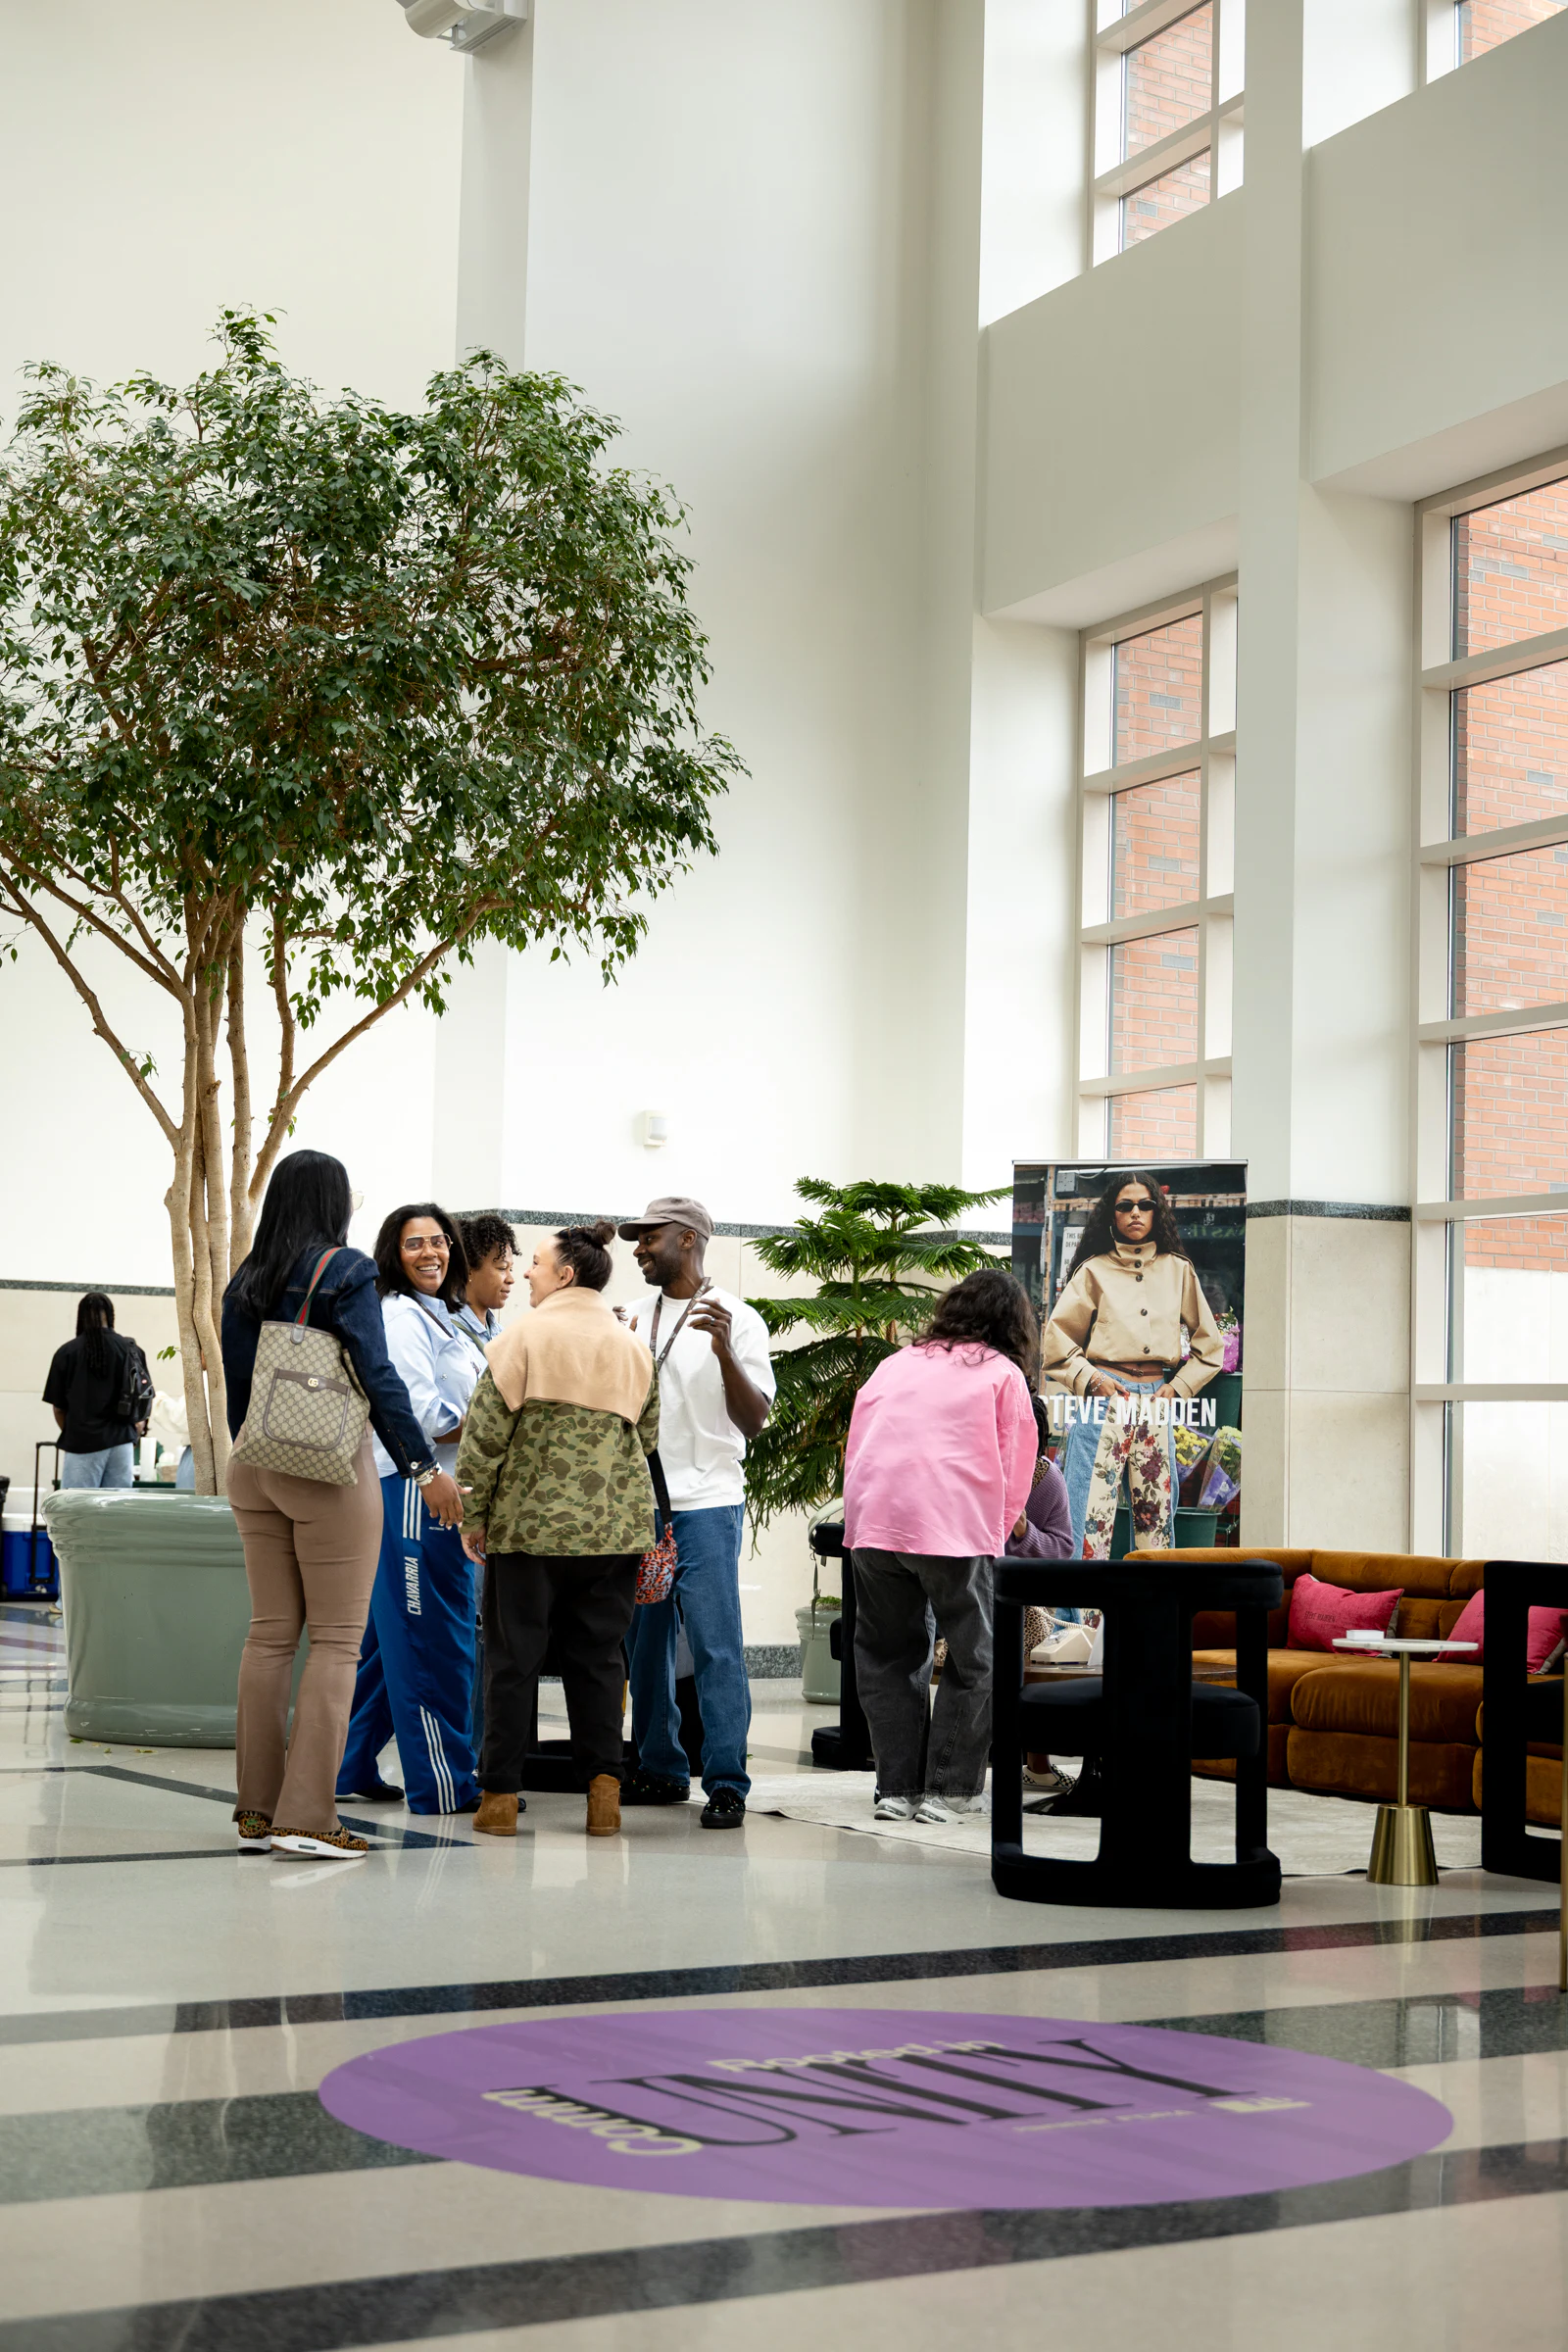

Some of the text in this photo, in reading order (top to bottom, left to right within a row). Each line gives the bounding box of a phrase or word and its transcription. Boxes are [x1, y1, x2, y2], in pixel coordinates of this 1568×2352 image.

[1038, 1395, 1216, 1427] TEVE MADDEN
[405, 1556, 422, 1616] CHAVARRIA
[707, 2039, 1005, 2073] Rooted in
[489, 2037, 1256, 2147] UNITY
[480, 2088, 704, 2157] Comm
